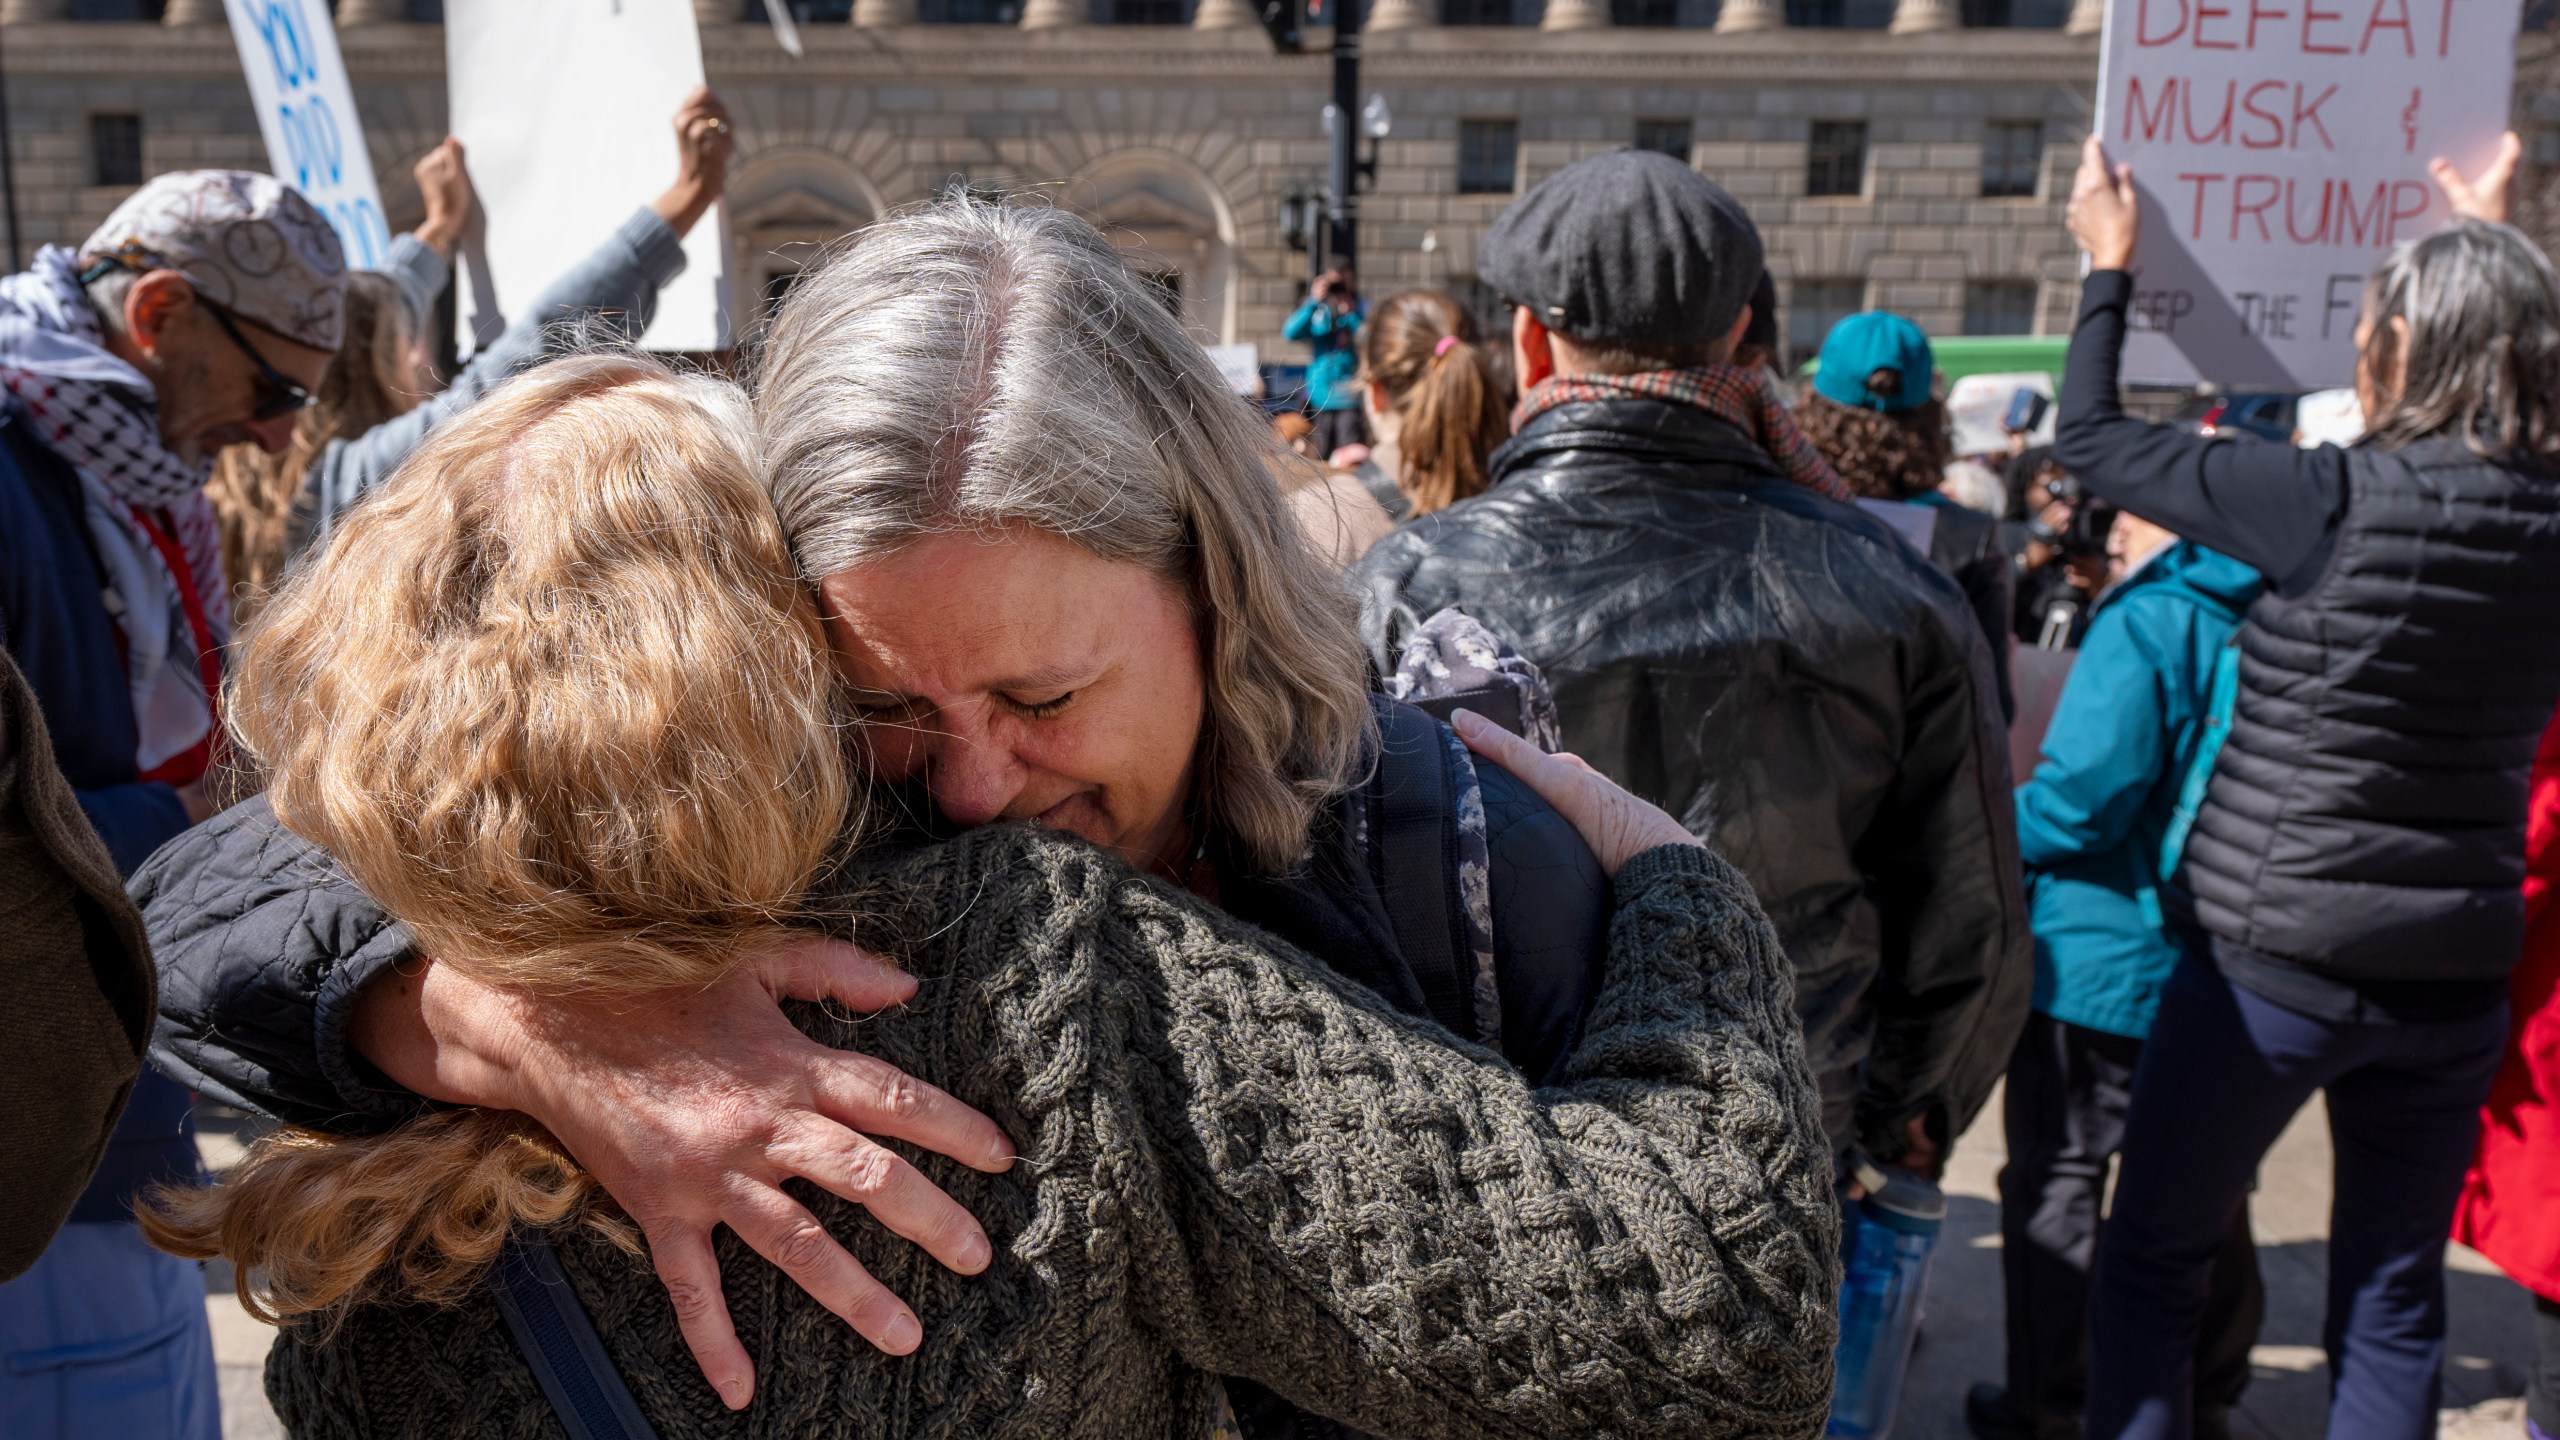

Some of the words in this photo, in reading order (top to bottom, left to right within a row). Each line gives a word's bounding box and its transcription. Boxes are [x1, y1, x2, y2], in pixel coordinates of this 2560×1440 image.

[2136, 0, 2474, 58] DEFEAT
[2121, 75, 2340, 152] MUSK
[2177, 172, 2431, 249] TRUMP
[2130, 266, 2195, 336] EEP
[2235, 289, 2299, 340] THE
